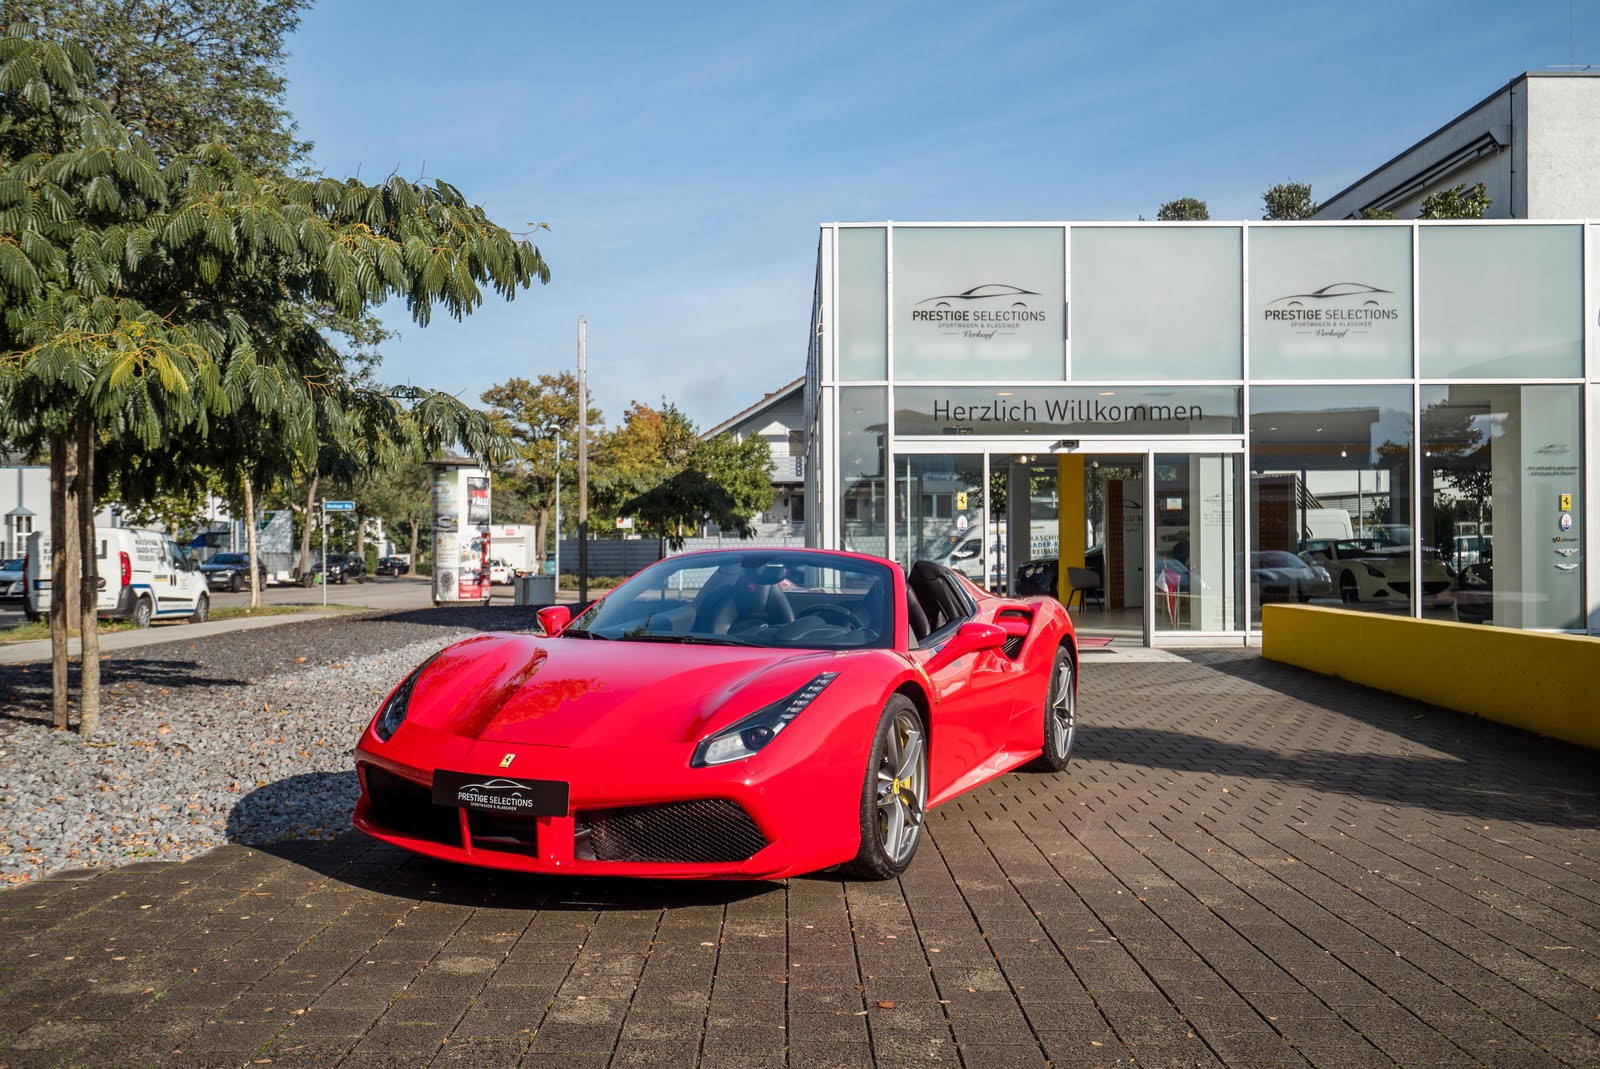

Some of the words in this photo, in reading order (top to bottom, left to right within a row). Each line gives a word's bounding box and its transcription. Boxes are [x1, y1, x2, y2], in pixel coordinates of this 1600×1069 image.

[912, 310, 970, 321] PRESTIGE
[973, 310, 1046, 321] SELECTIONS
[1264, 309, 1322, 321] PRESTIGE
[1325, 309, 1398, 320] SELECTIONS
[934, 400, 1036, 421] Herzlich
[1045, 400, 1202, 421] Willkommen
[458, 792, 488, 803] PRESTIGE
[489, 796, 533, 807] SELECTIONS
